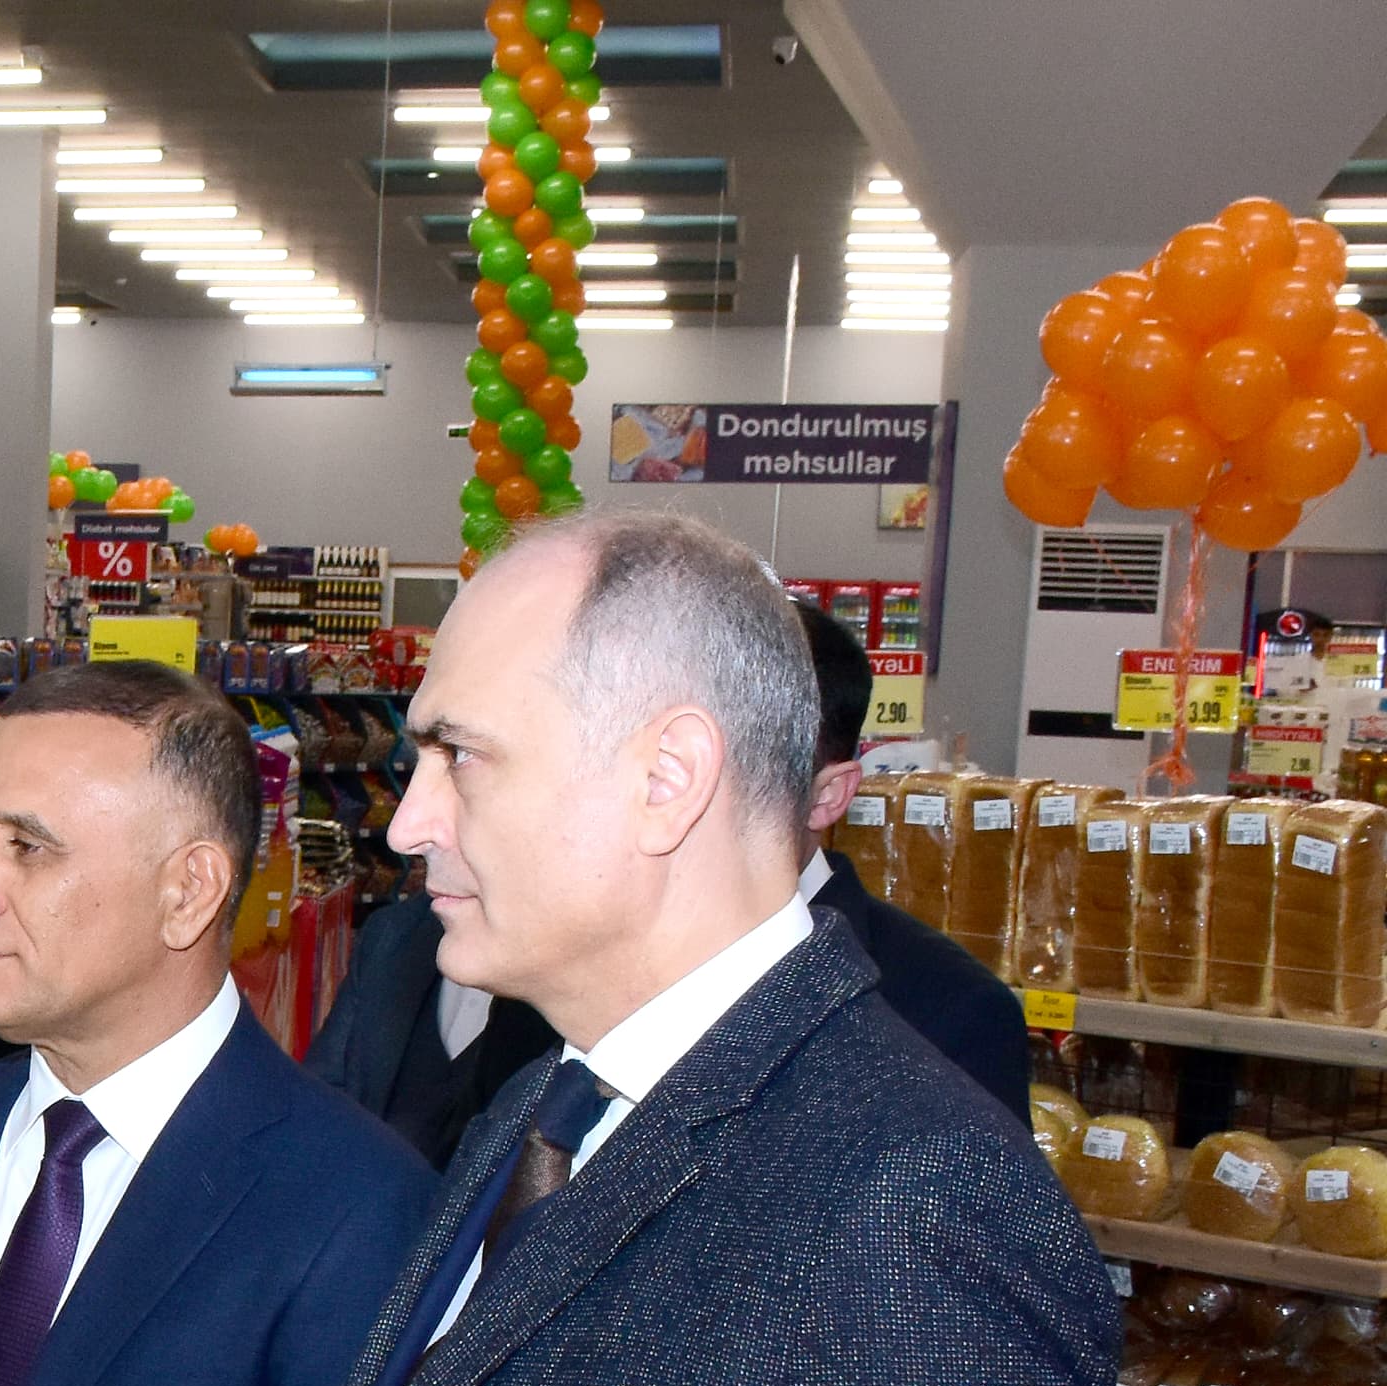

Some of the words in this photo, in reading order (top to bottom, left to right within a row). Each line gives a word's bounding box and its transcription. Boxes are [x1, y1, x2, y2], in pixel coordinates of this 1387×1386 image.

[717, 412, 927, 442] Dondurulmuş
[744, 450, 896, 474] məhsullar
[876, 702, 907, 724] 2.90
[1188, 701, 1222, 724] 3.99
